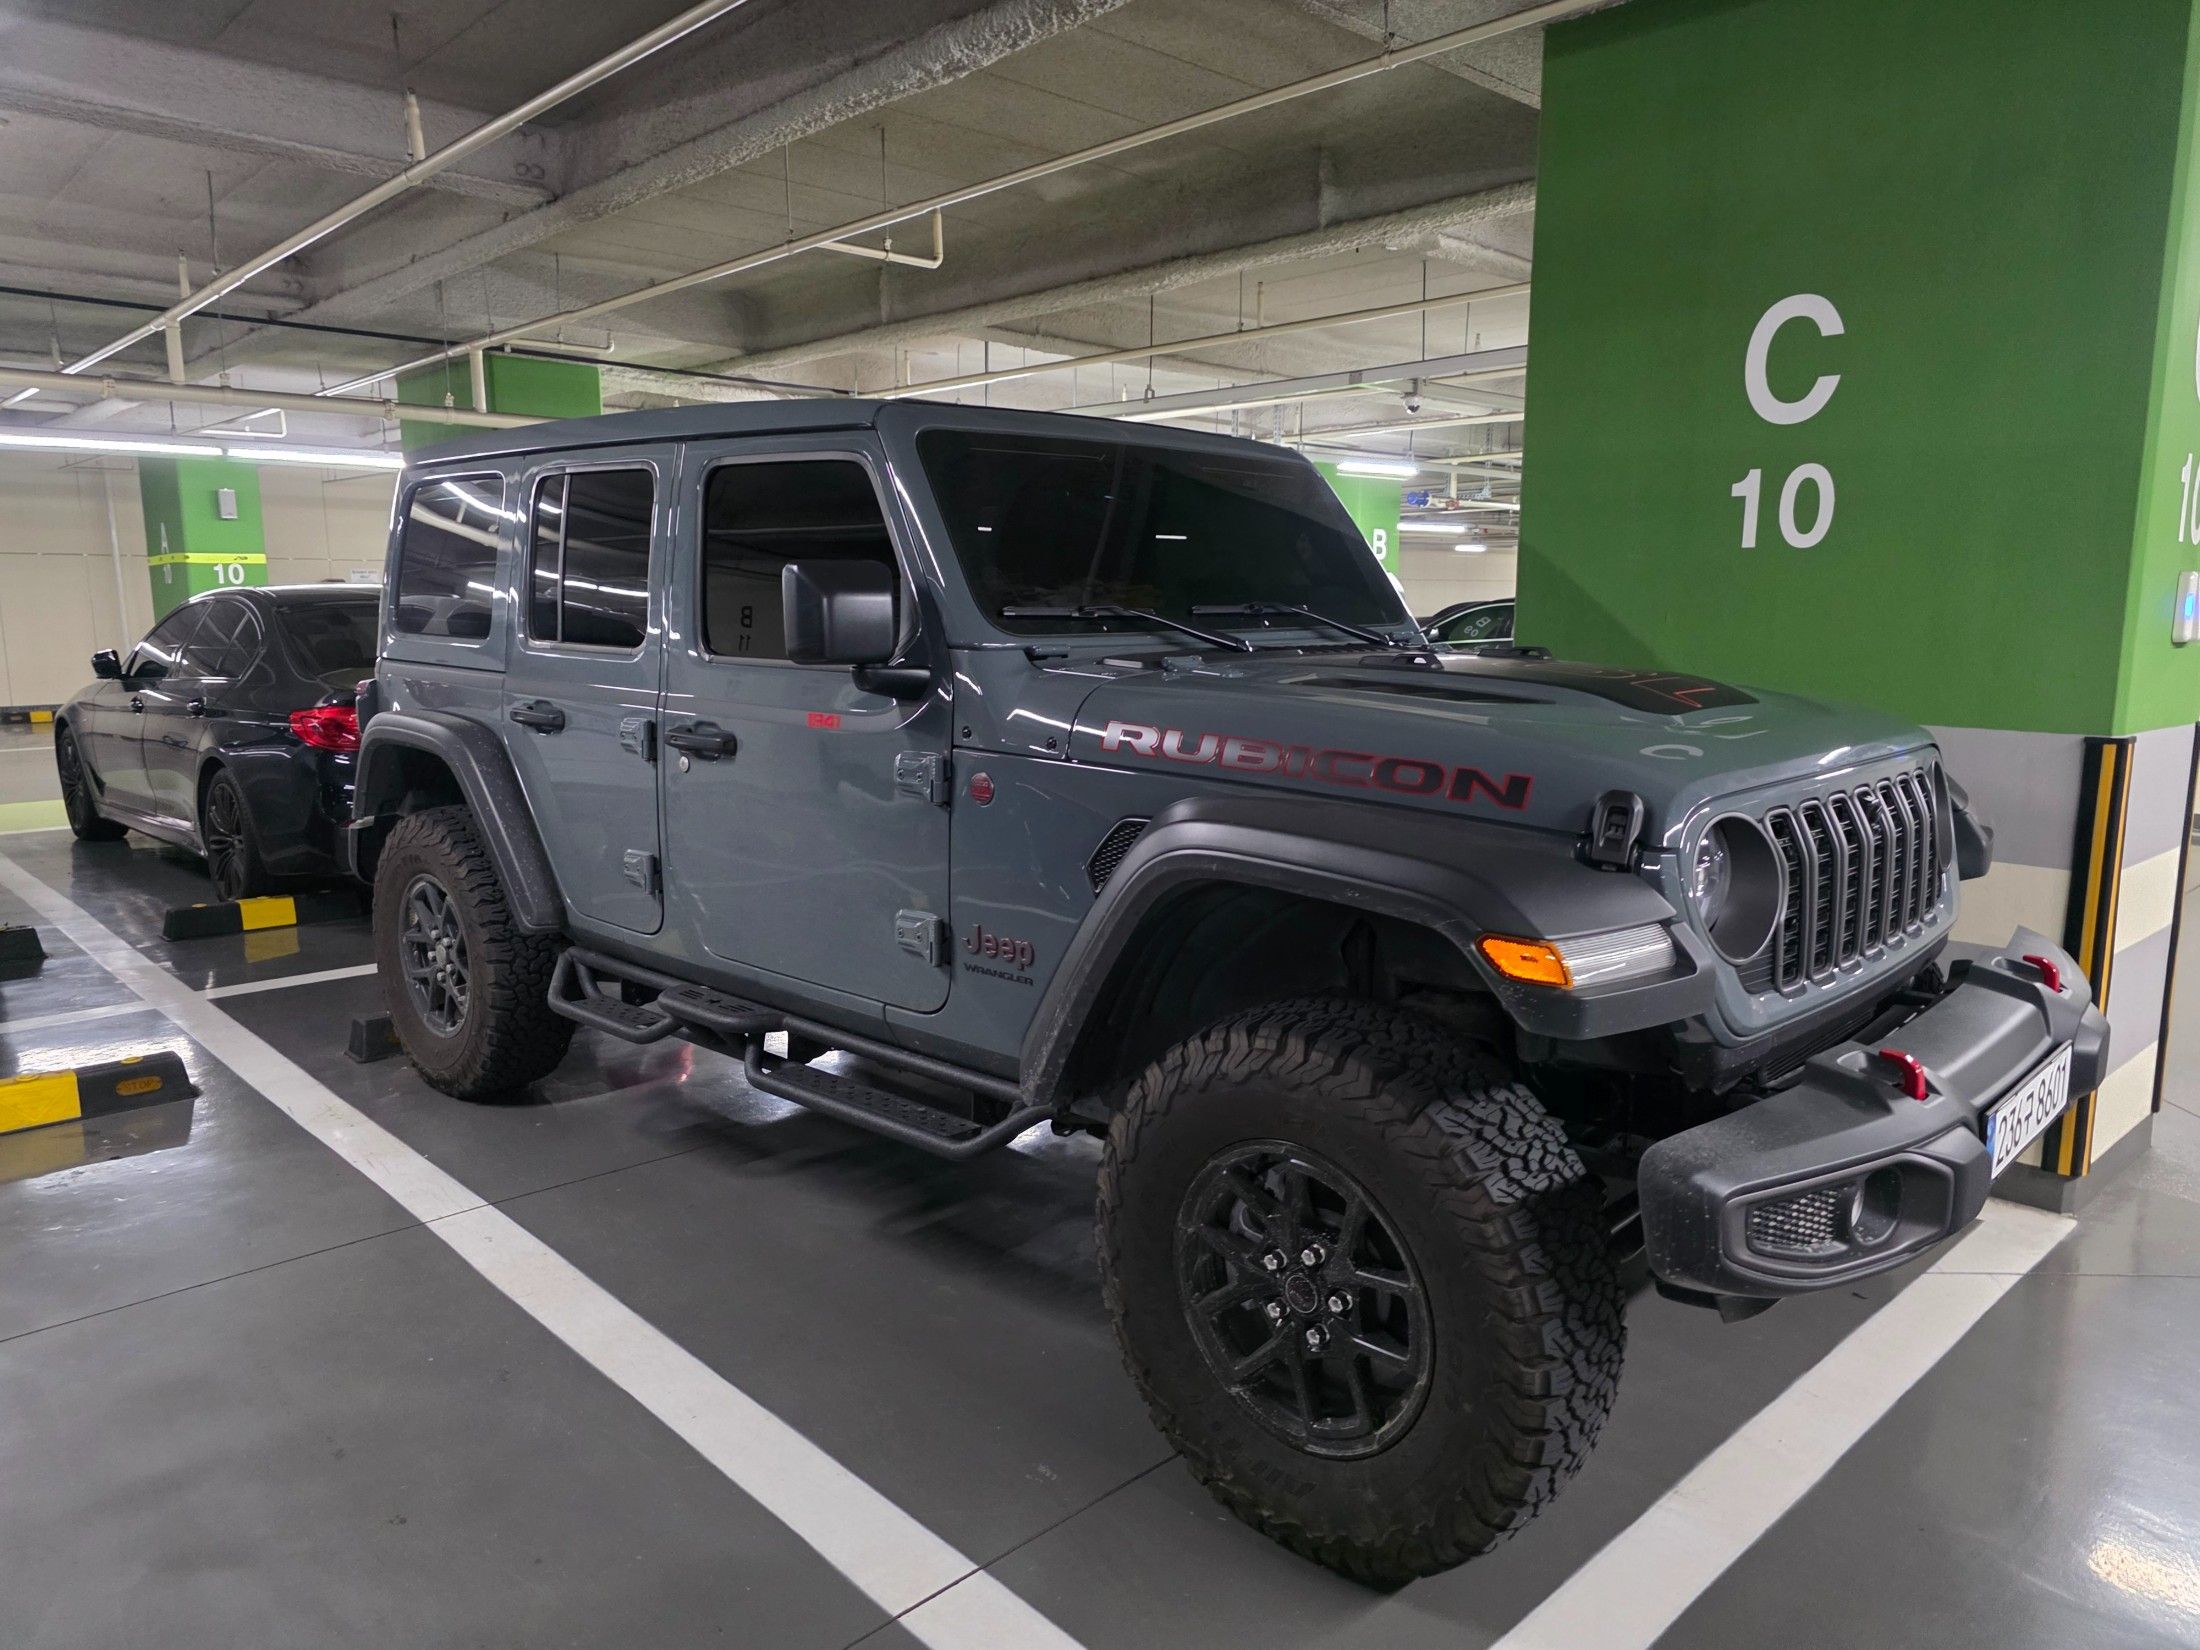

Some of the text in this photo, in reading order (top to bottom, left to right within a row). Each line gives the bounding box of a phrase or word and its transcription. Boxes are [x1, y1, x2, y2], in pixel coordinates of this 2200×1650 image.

[1744, 293, 1845, 425] C
[1731, 462, 1836, 549] 10
[213, 563, 245, 585] 10
[1372, 527, 1387, 561] B
[1102, 720, 1534, 811] RUBICON
[960, 923, 1035, 971] Jeep
[963, 962, 1034, 986] WRANGLER
[1995, 1057, 2068, 1168] 236구 8601
